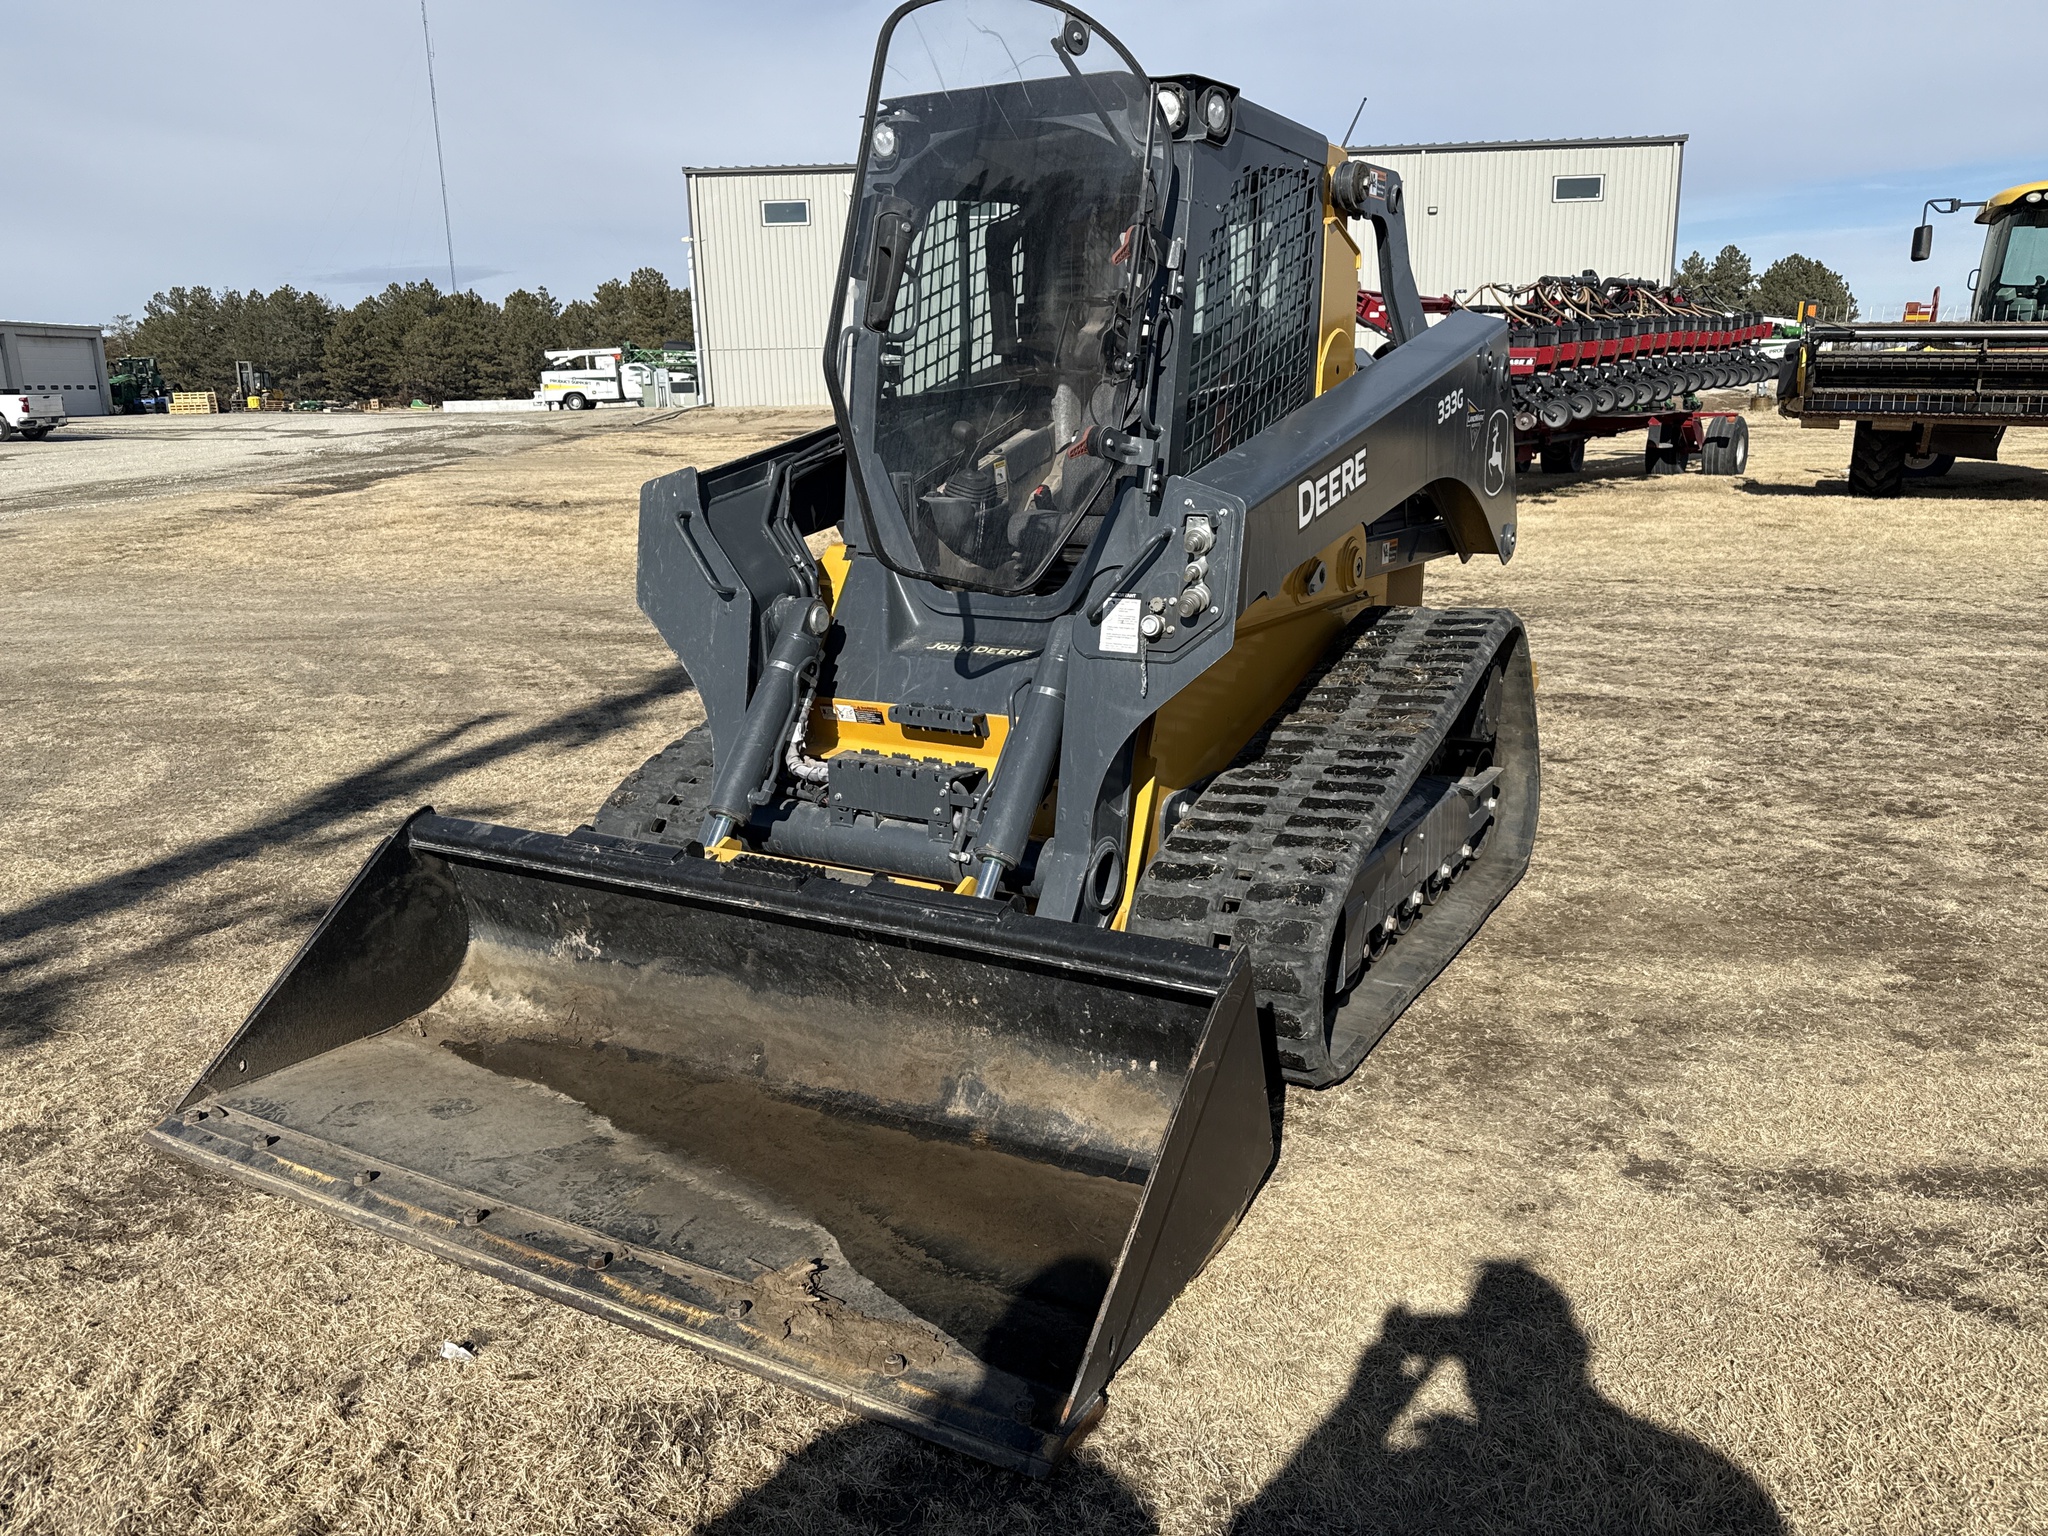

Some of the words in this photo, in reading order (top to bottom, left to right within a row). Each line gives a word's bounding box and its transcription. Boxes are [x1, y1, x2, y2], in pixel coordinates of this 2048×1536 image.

[1437, 387, 1464, 425] 333G
[1298, 447, 1367, 530] DEERE
[926, 642, 973, 652] JOHN
[973, 646, 1034, 656] DEERE
